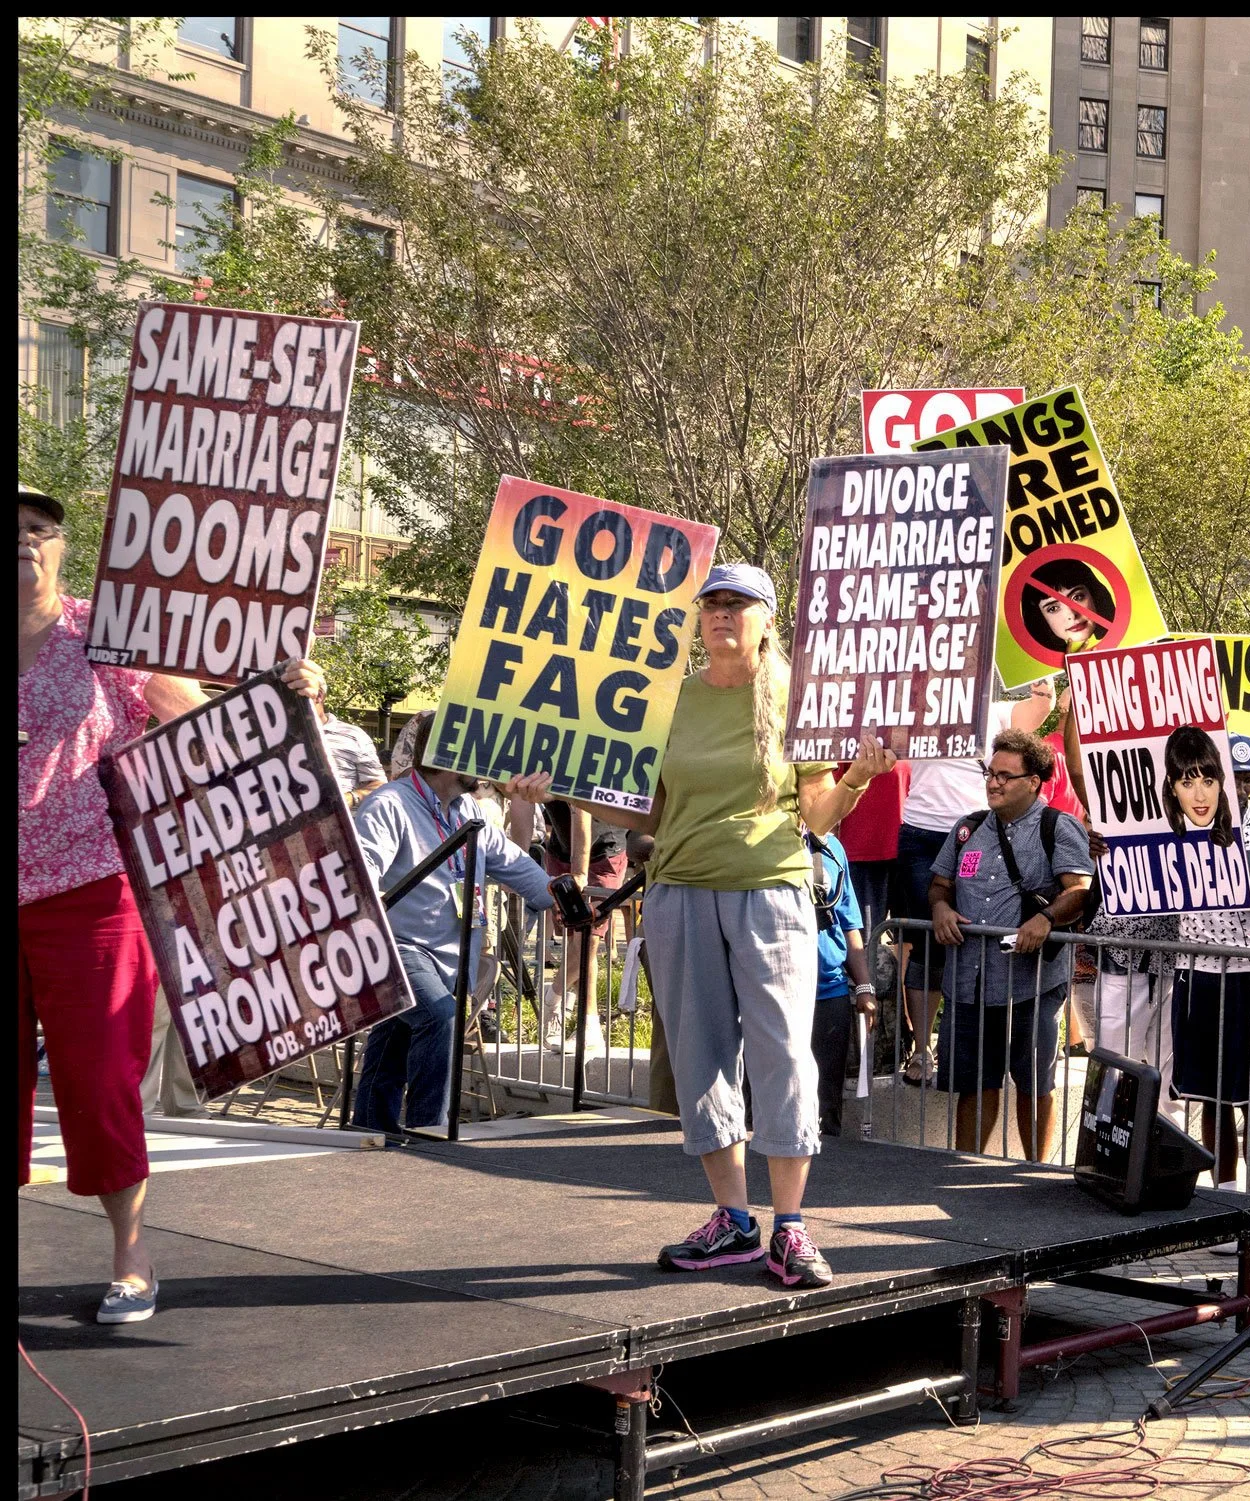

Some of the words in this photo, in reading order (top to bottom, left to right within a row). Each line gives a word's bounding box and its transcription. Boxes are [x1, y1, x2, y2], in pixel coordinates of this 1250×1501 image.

[132, 308, 353, 411] SAME-SEX
[119, 400, 336, 500] MARRIAGE
[917, 391, 1085, 455] NGS
[841, 463, 970, 517] DIVORCE
[1005, 440, 1099, 513] RE
[108, 488, 320, 595] DOOMS
[512, 495, 692, 594] GOD
[810, 517, 994, 572] REMARRIAGE
[1002, 487, 1120, 567] OMED
[90, 579, 310, 676] NATIONS
[479, 567, 687, 670] HATES
[808, 576, 829, 624] &
[837, 569, 983, 624] SAME-SEX
[87, 648, 117, 664] JUDE
[119, 653, 130, 665] 7
[476, 639, 652, 733] FAG
[1069, 655, 1144, 735] BANG
[1142, 645, 1221, 727] BANG
[796, 681, 856, 729] ARE
[861, 679, 915, 727] ALL
[923, 677, 975, 726] SIN
[117, 683, 288, 814] WICKED
[432, 702, 658, 798] ENABLERS
[792, 739, 835, 761] MATT.
[909, 736, 942, 759] HEB.
[946, 734, 976, 758] 13:4
[1088, 747, 1163, 824] YOUR
[132, 743, 321, 889] LEADERS
[594, 790, 618, 804] RO.
[216, 843, 266, 899] ARE
[1101, 845, 1161, 914] SOUL
[1159, 842, 1184, 910] IS
[1182, 839, 1247, 908] DEAD
[174, 925, 214, 994] A
[216, 850, 359, 969] CURSE
[180, 961, 301, 1068] FROM
[300, 919, 390, 1009] GOD
[264, 1031, 304, 1066] JOB.
[304, 1010, 343, 1046] 9:24
[1084, 1111, 1097, 1132] HOME
[1112, 1125, 1130, 1148] GUEST
